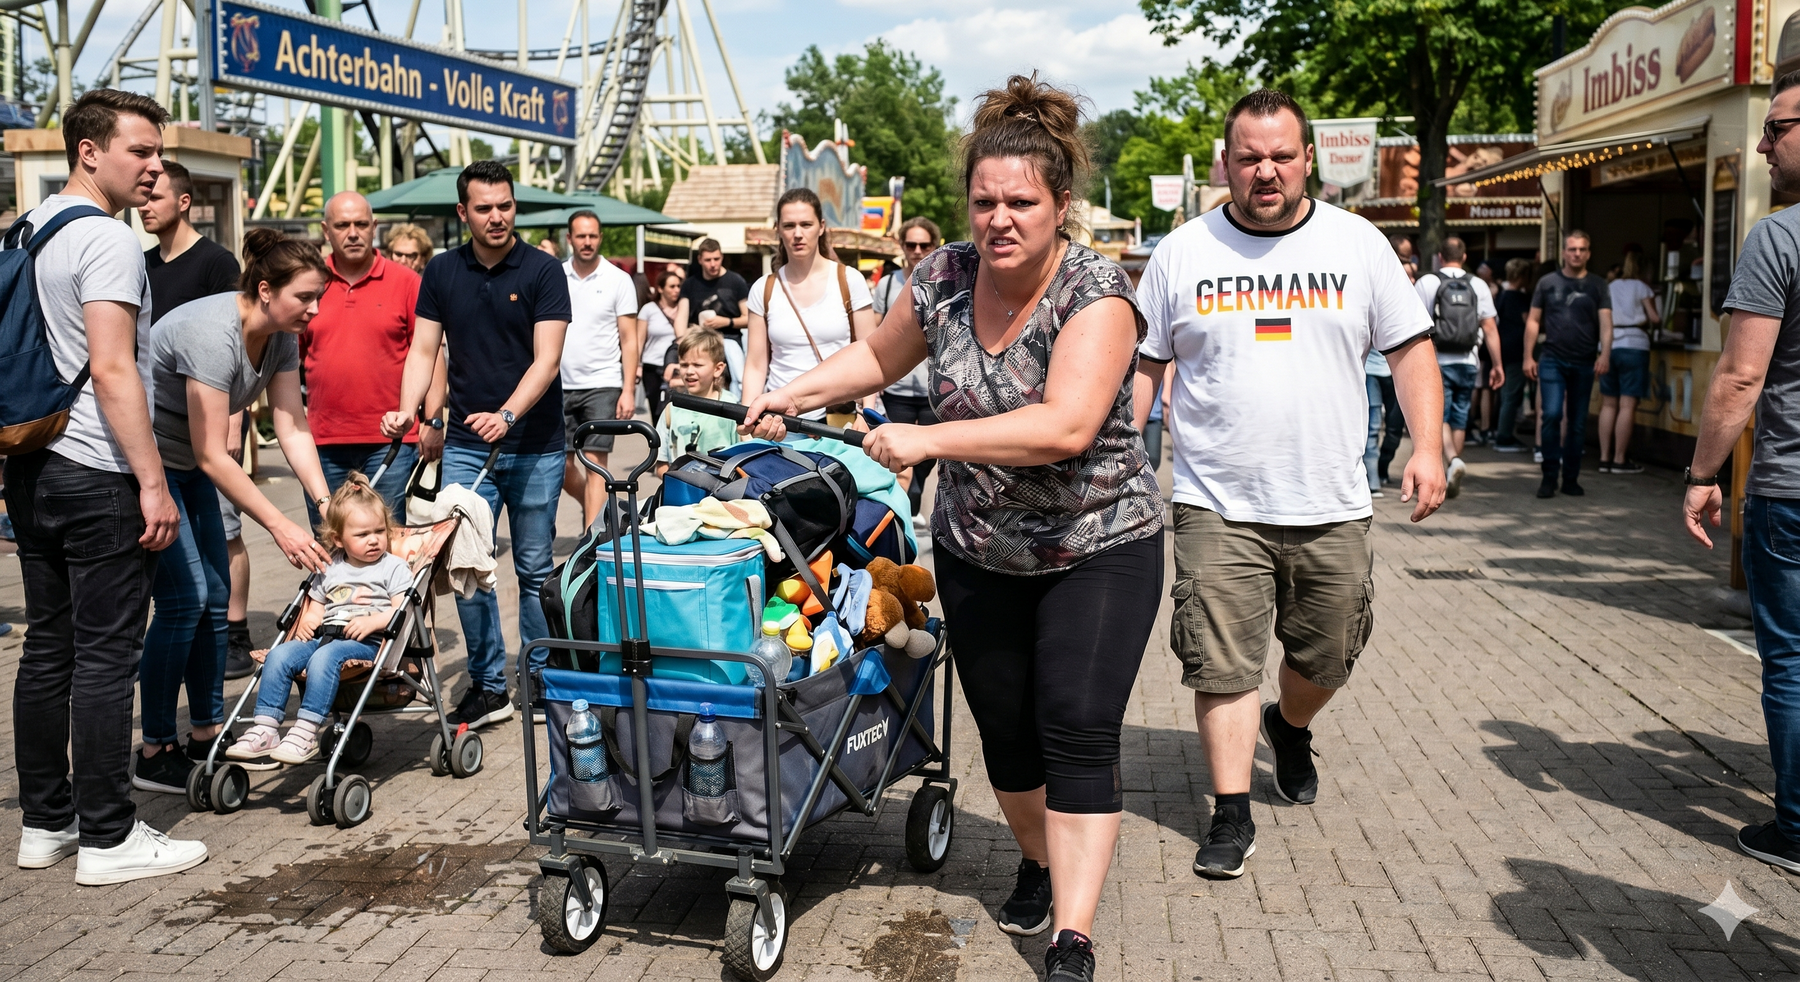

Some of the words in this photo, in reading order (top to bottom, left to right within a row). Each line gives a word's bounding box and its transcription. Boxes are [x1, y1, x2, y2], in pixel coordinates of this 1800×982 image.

[275, 30, 422, 99] Achterbahn
[443, 68, 495, 114] Volle
[500, 81, 545, 124] Kraft
[1583, 43, 1661, 115] Imbiss
[1320, 130, 1370, 148] Imbiss
[1196, 272, 1347, 315] GERMANY
[847, 723, 883, 755] FUXTEC
